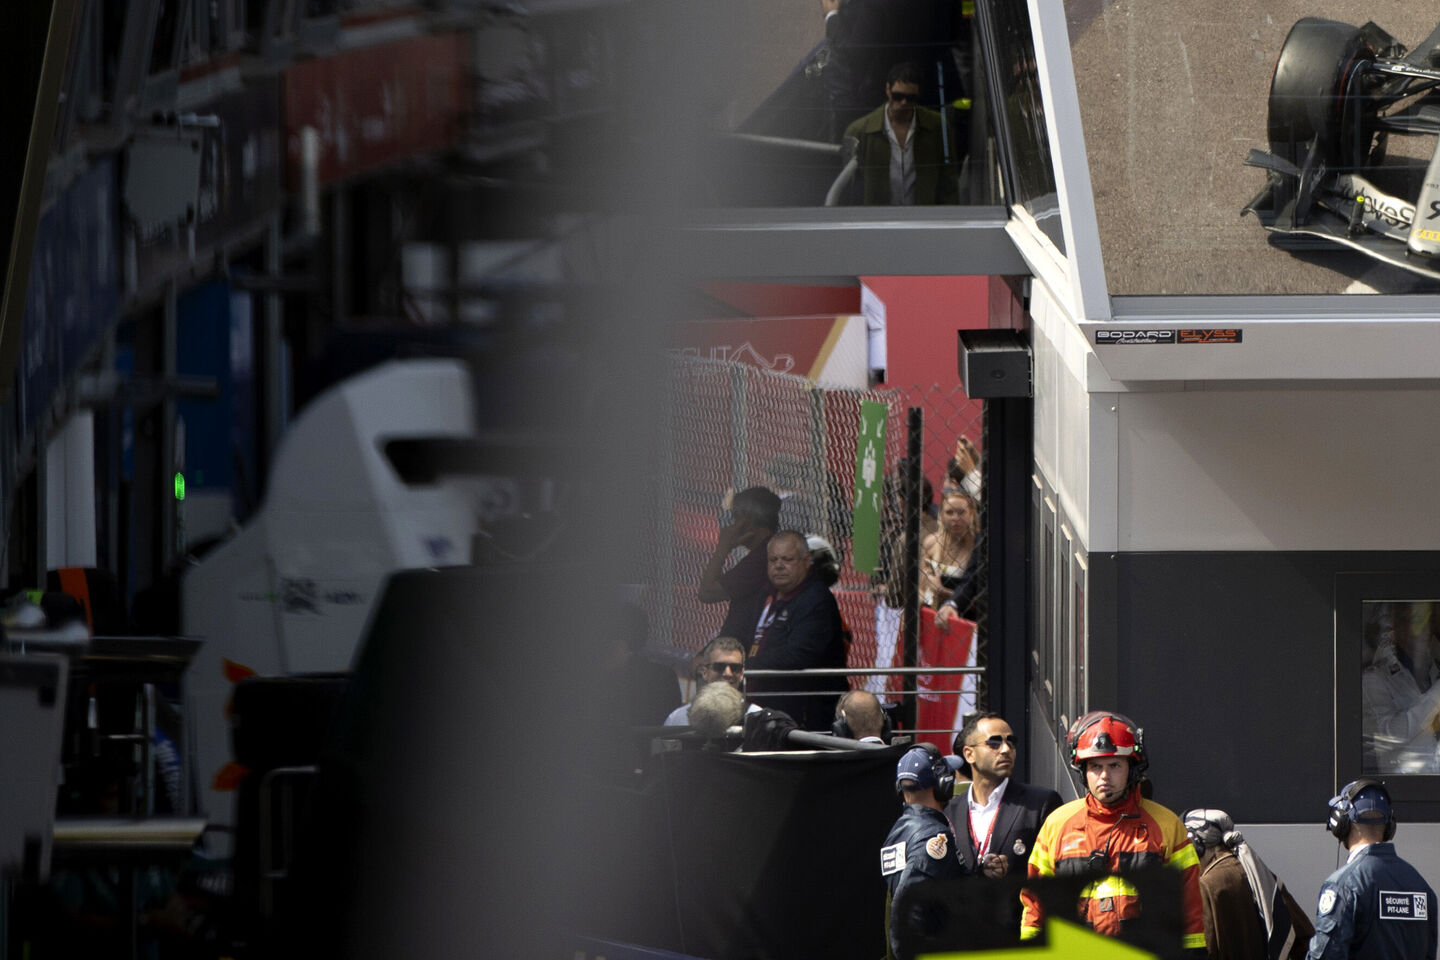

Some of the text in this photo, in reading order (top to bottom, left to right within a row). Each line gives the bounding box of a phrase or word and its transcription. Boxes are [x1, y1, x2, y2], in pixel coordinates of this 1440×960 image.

[1180, 329, 1237, 339] ELYSS
[1385, 896, 1410, 905] SÉCURITÉ
[1387, 906, 1410, 914] PIT-LANE
